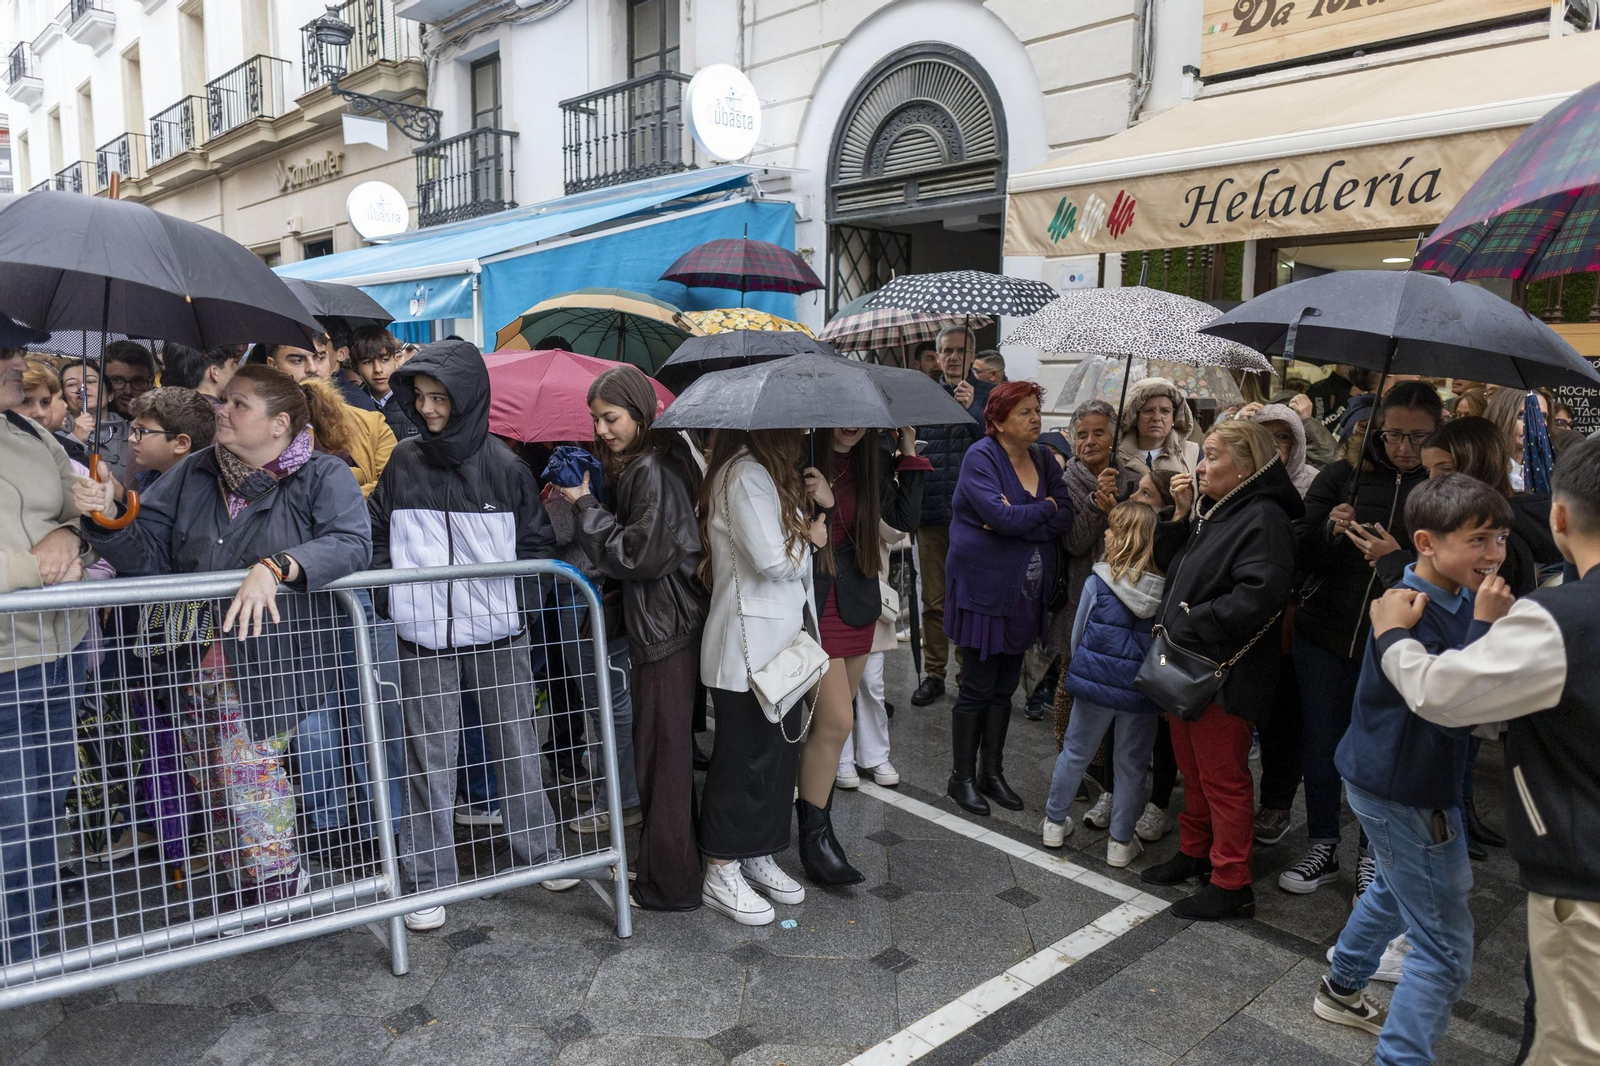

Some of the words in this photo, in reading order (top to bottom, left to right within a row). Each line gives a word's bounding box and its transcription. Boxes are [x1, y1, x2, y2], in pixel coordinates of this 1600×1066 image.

[1233, 0, 1295, 37] Da
[708, 105, 754, 130] ubasta
[286, 150, 344, 188] Santander
[1180, 156, 1442, 228] Heladería
[364, 208, 402, 224] ubasta
